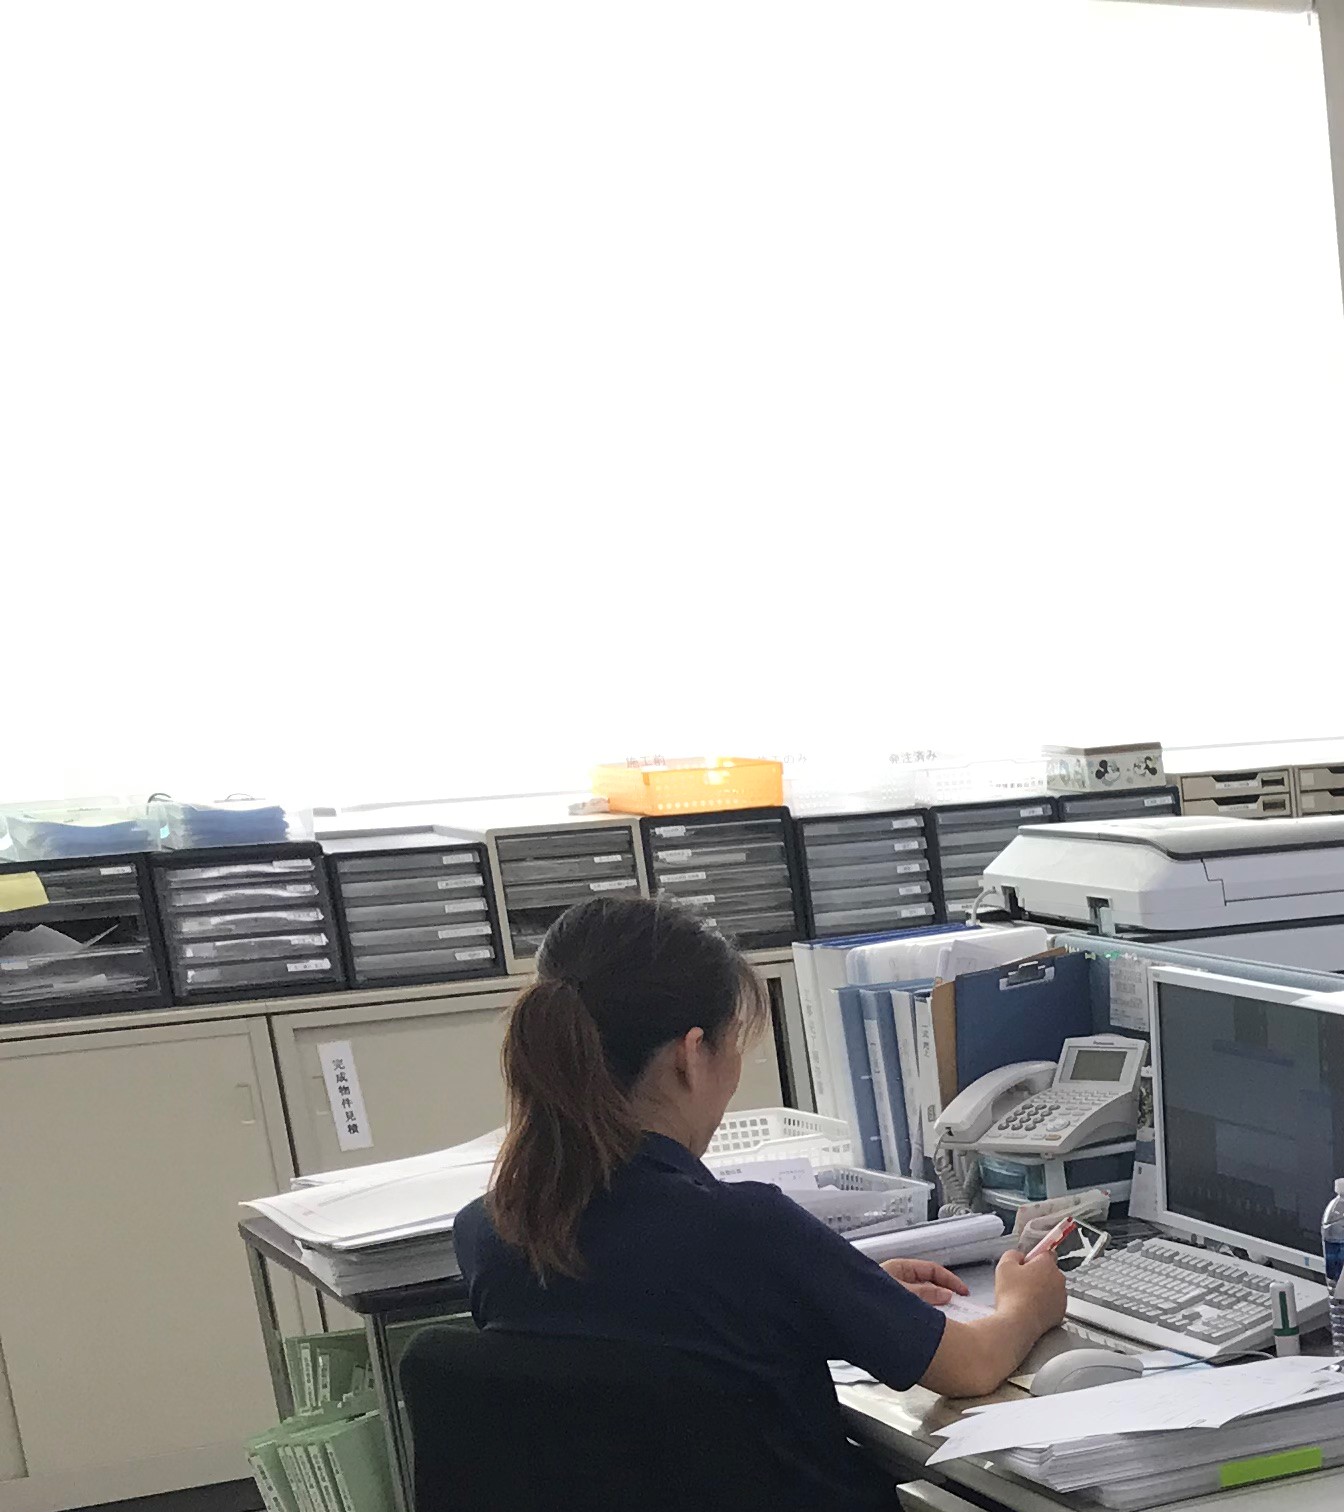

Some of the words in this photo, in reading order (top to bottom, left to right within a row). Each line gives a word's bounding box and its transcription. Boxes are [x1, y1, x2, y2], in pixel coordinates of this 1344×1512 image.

[332, 1058, 360, 1135] 完成物件見積
